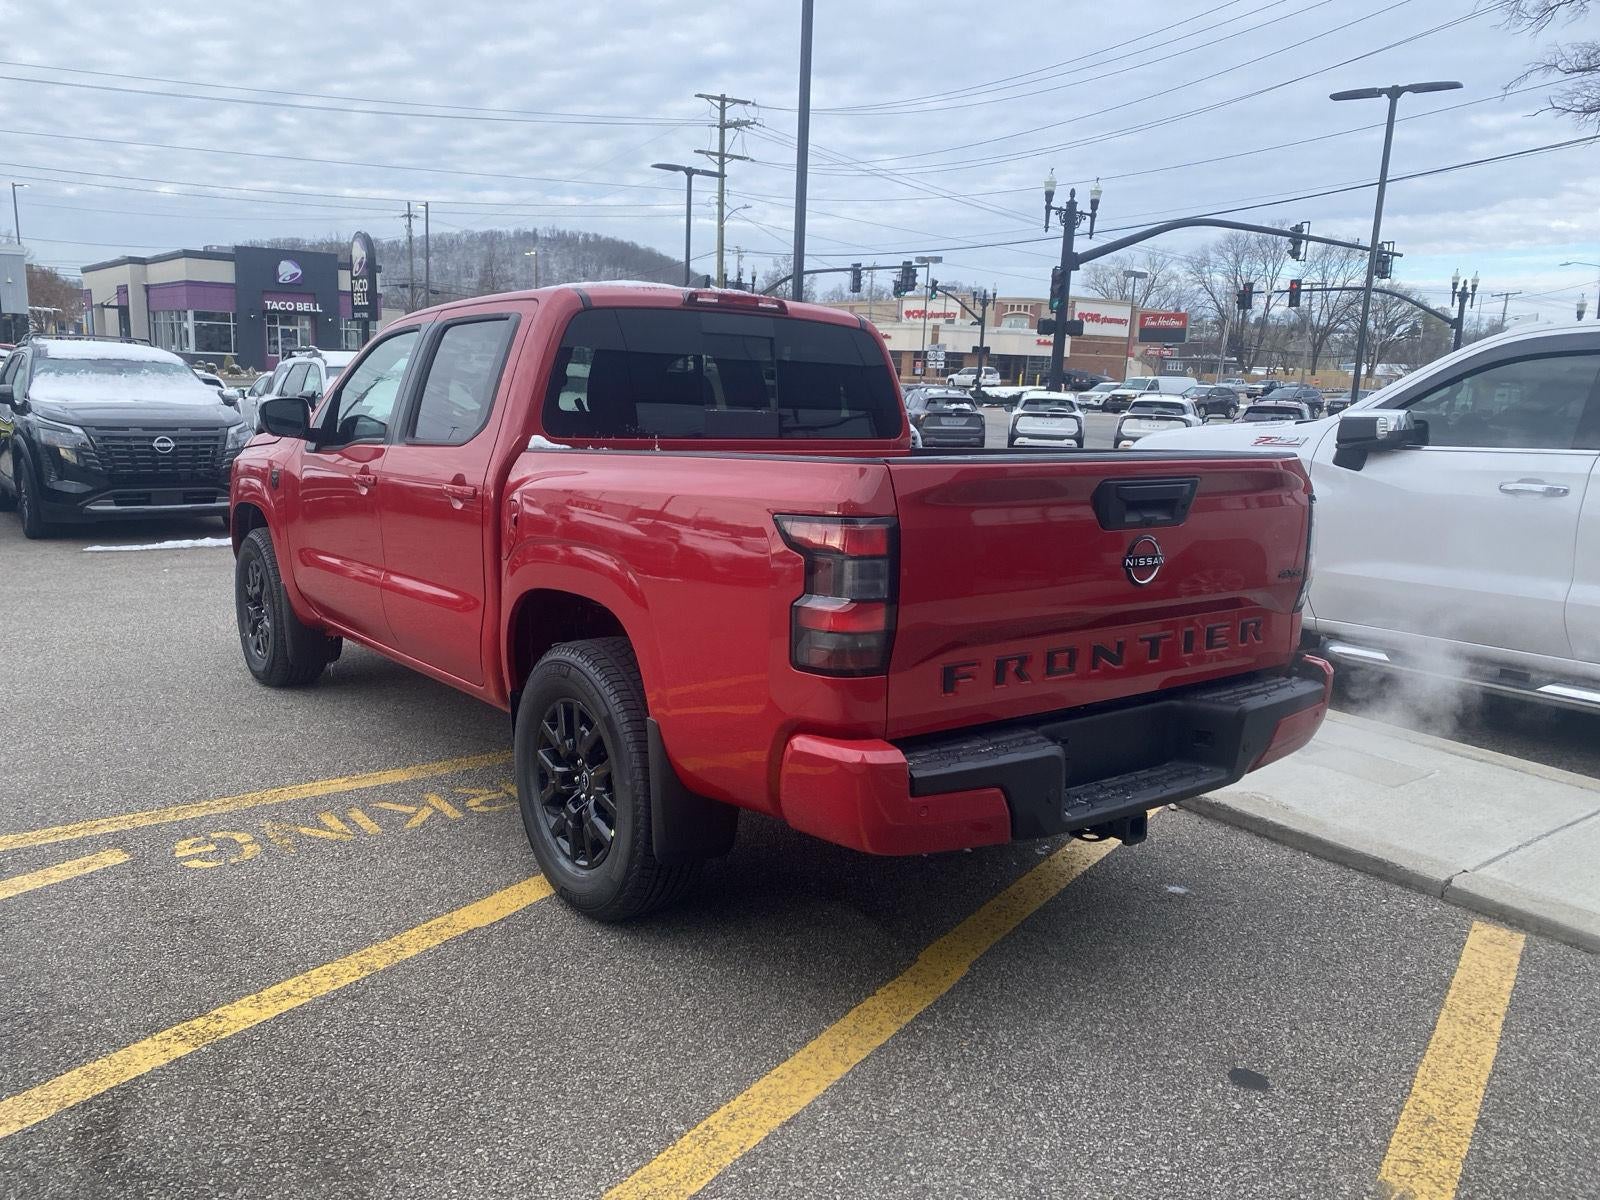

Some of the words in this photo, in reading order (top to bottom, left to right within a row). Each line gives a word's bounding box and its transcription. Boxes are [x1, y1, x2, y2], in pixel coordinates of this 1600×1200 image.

[352, 279, 368, 292] TACO
[353, 293, 369, 306] BELL
[265, 300, 295, 311] TACO
[296, 302, 323, 313] BELL
[927, 311, 957, 320] pharmacy
[1085, 312, 1101, 323] CVS
[1101, 315, 1129, 327] pharmacy
[1144, 316, 1158, 327] Tim
[1157, 315, 1183, 327] Hortons
[1125, 555, 1164, 568] NISSAN
[941, 616, 1264, 696] FRONTIER
[174, 777, 518, 868] RKING
